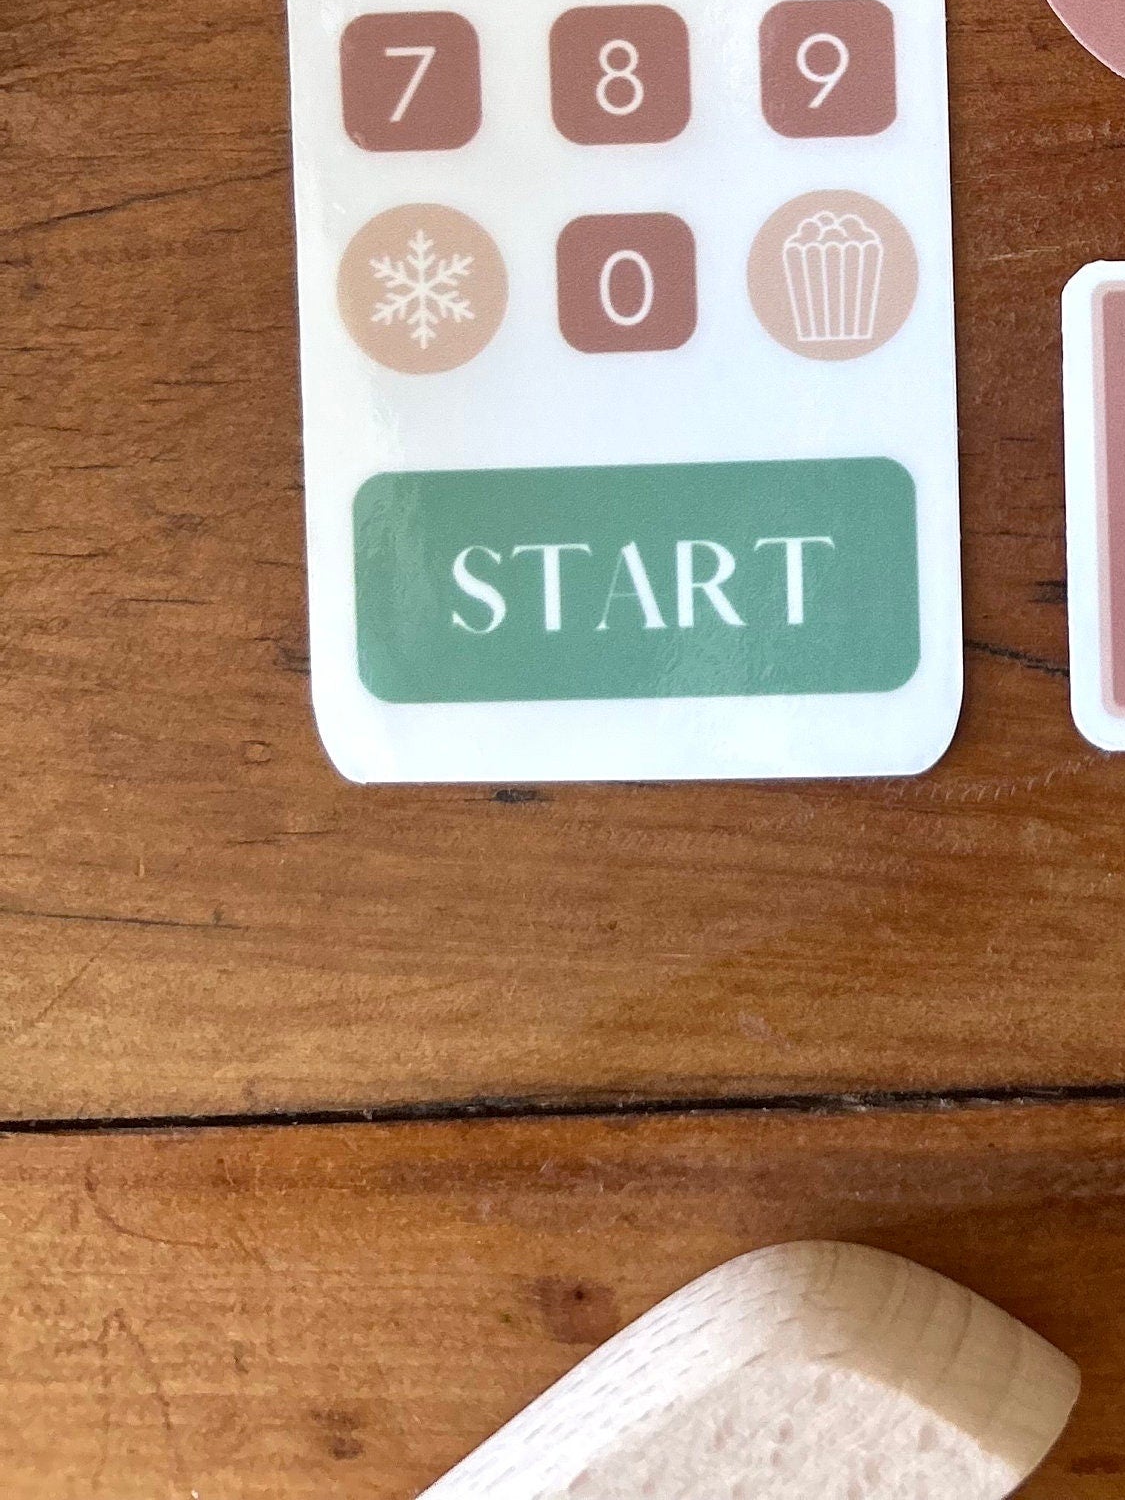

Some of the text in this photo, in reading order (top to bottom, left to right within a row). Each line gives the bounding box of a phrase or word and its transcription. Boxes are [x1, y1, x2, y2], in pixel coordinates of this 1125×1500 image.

[384, 32, 850, 123] 7 8 9
[599, 249, 655, 328] 0
[451, 536, 835, 634] START
